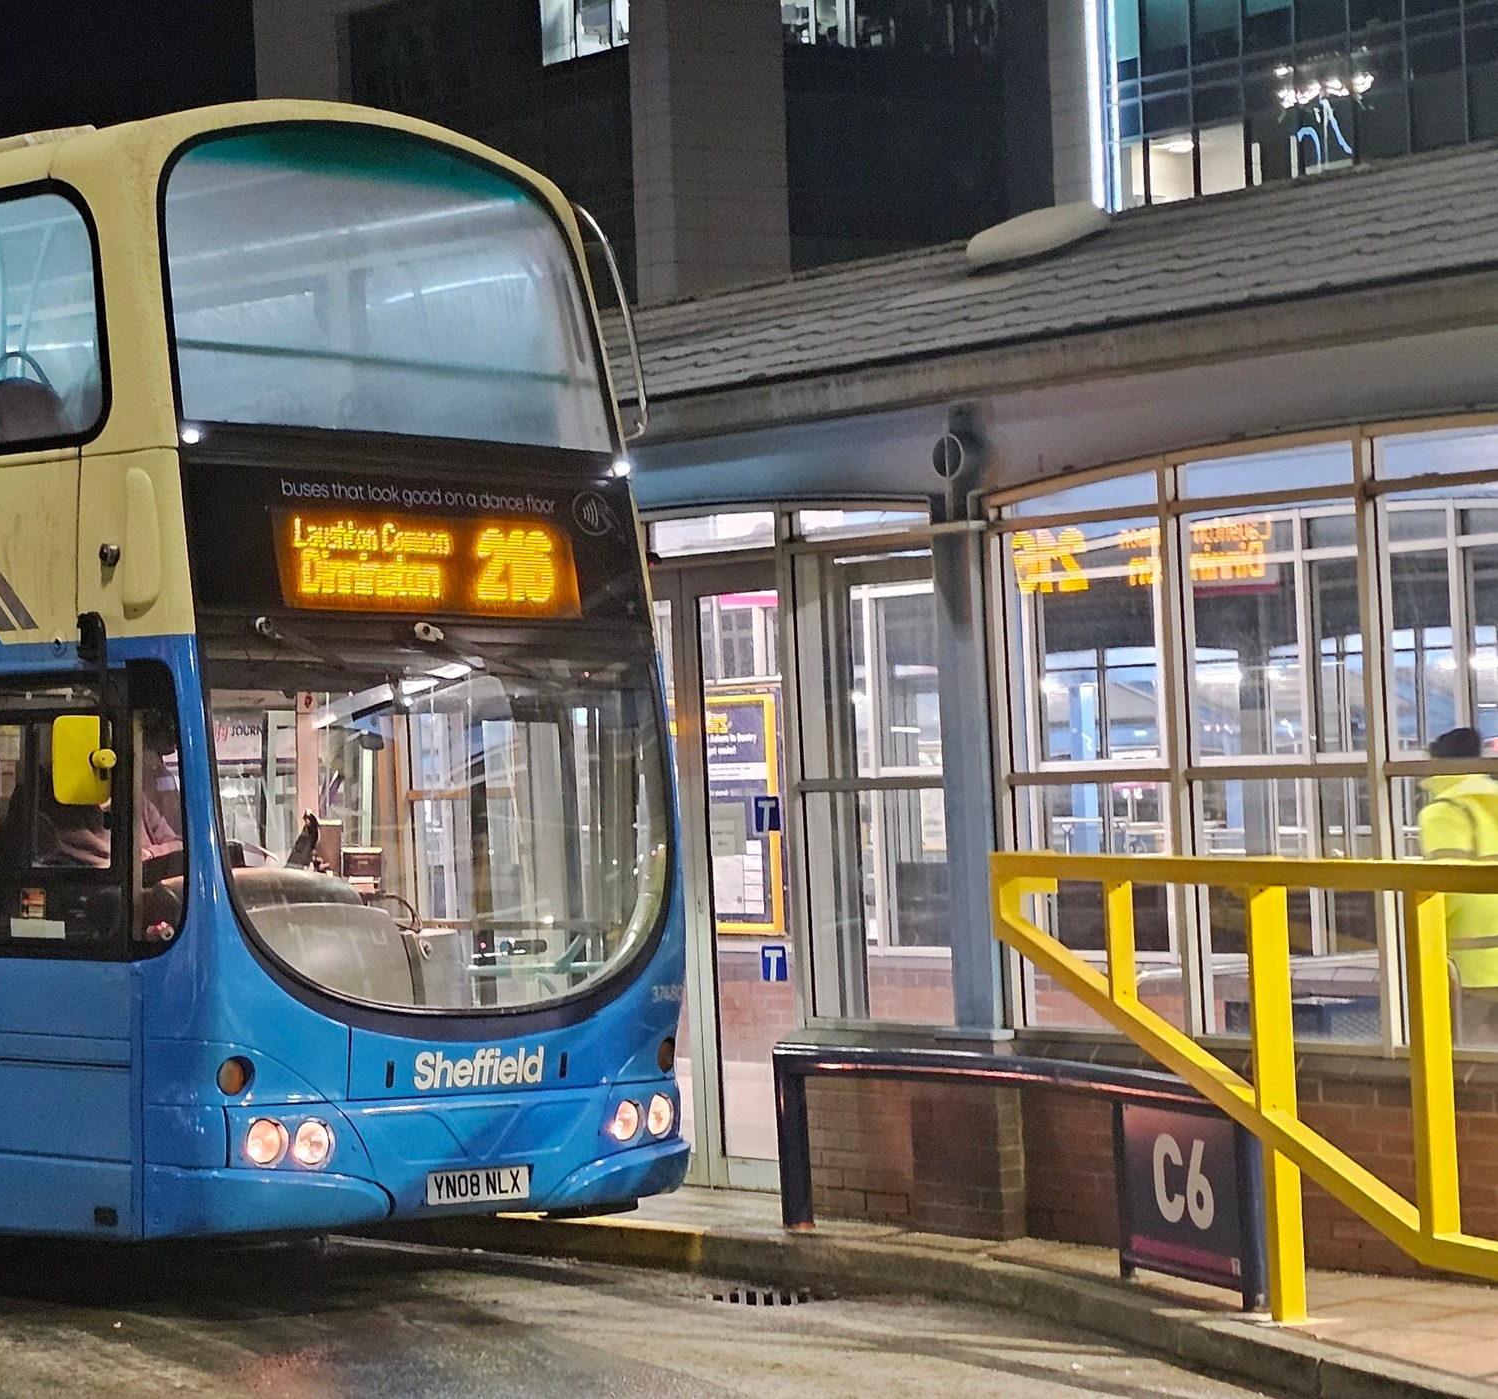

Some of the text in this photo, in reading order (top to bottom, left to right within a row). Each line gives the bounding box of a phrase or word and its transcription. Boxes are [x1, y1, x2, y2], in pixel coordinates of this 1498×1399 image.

[281, 478, 556, 514] buses that look good on a dance floor
[476, 527, 554, 604] 216
[413, 1046, 545, 1091] Sheffield
[434, 1168, 522, 1201] YN08 NLX
[1152, 1132, 1216, 1230] C6
